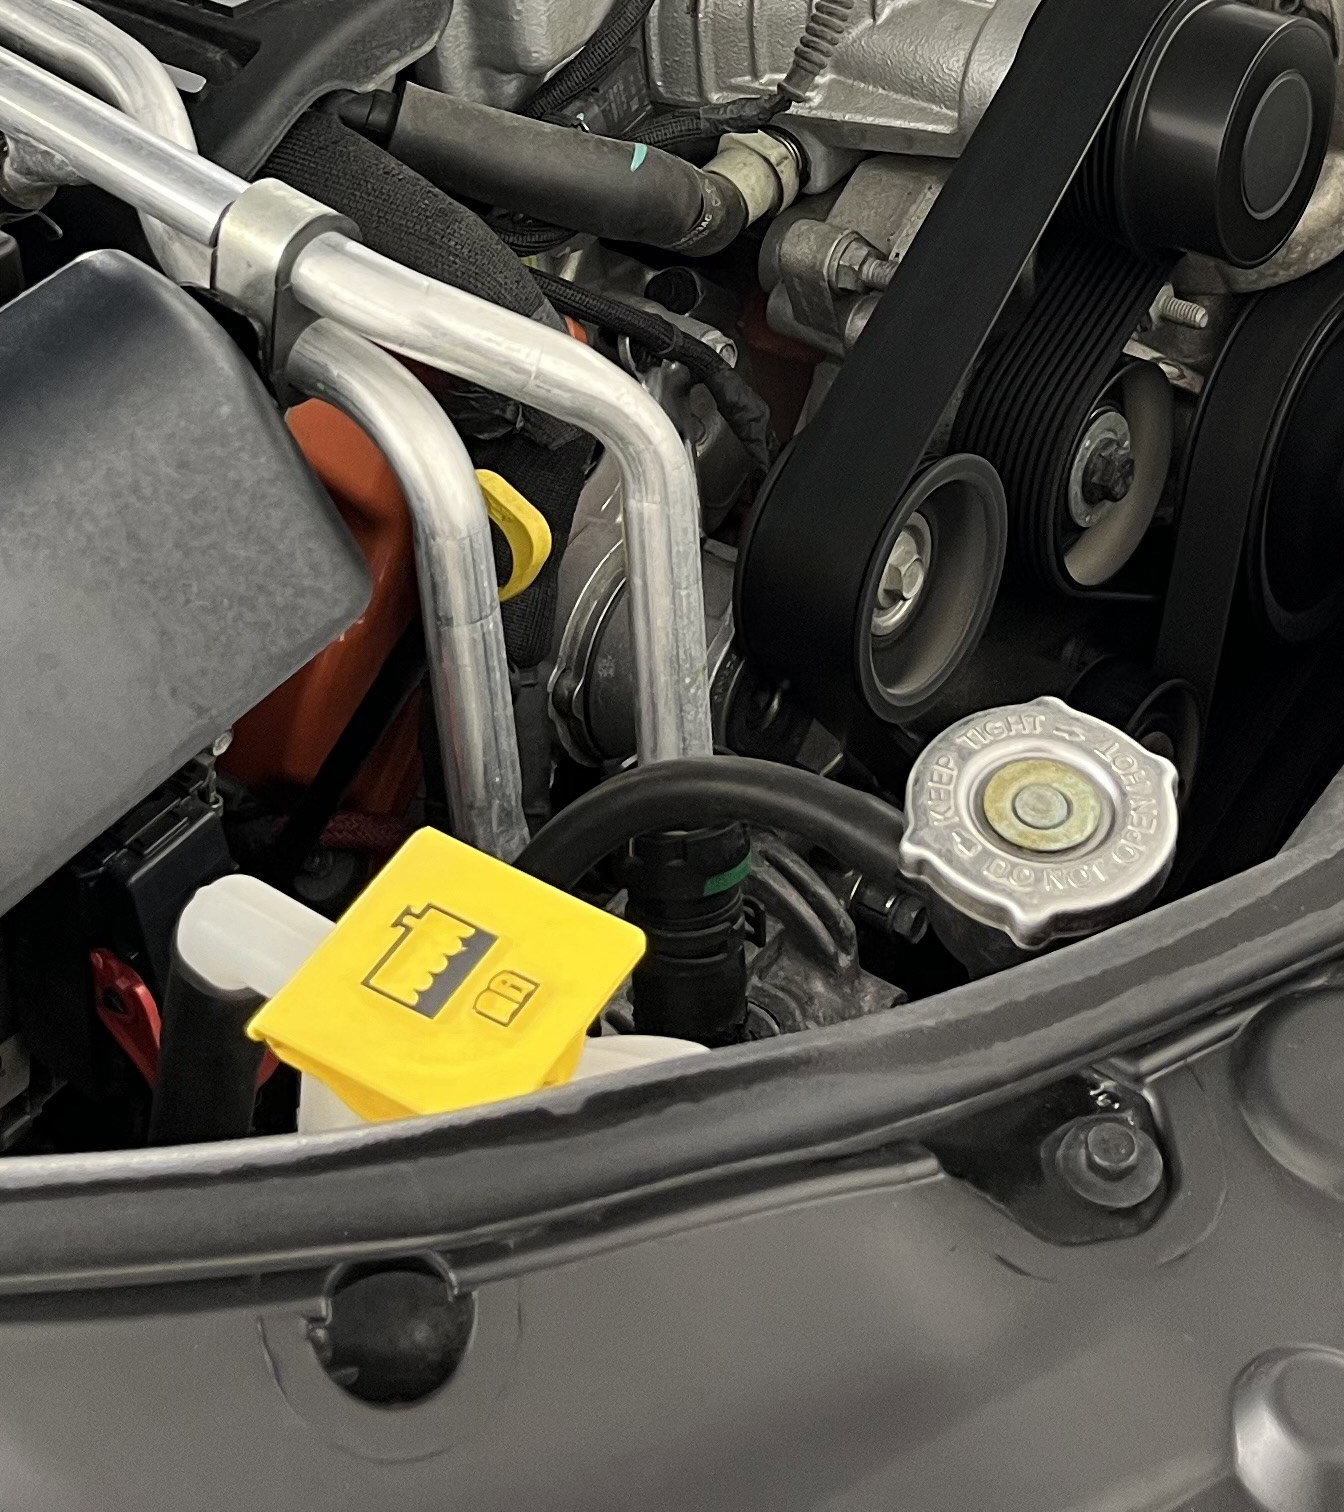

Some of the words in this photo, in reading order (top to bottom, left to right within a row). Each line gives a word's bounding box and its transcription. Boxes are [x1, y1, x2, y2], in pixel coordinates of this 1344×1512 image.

[926, 752, 960, 827] KEEP
[956, 713, 1046, 751] TIGHT
[981, 859, 1036, 887] DO
[1042, 857, 1108, 893] NOT
[1111, 793, 1159, 865] OPEN
